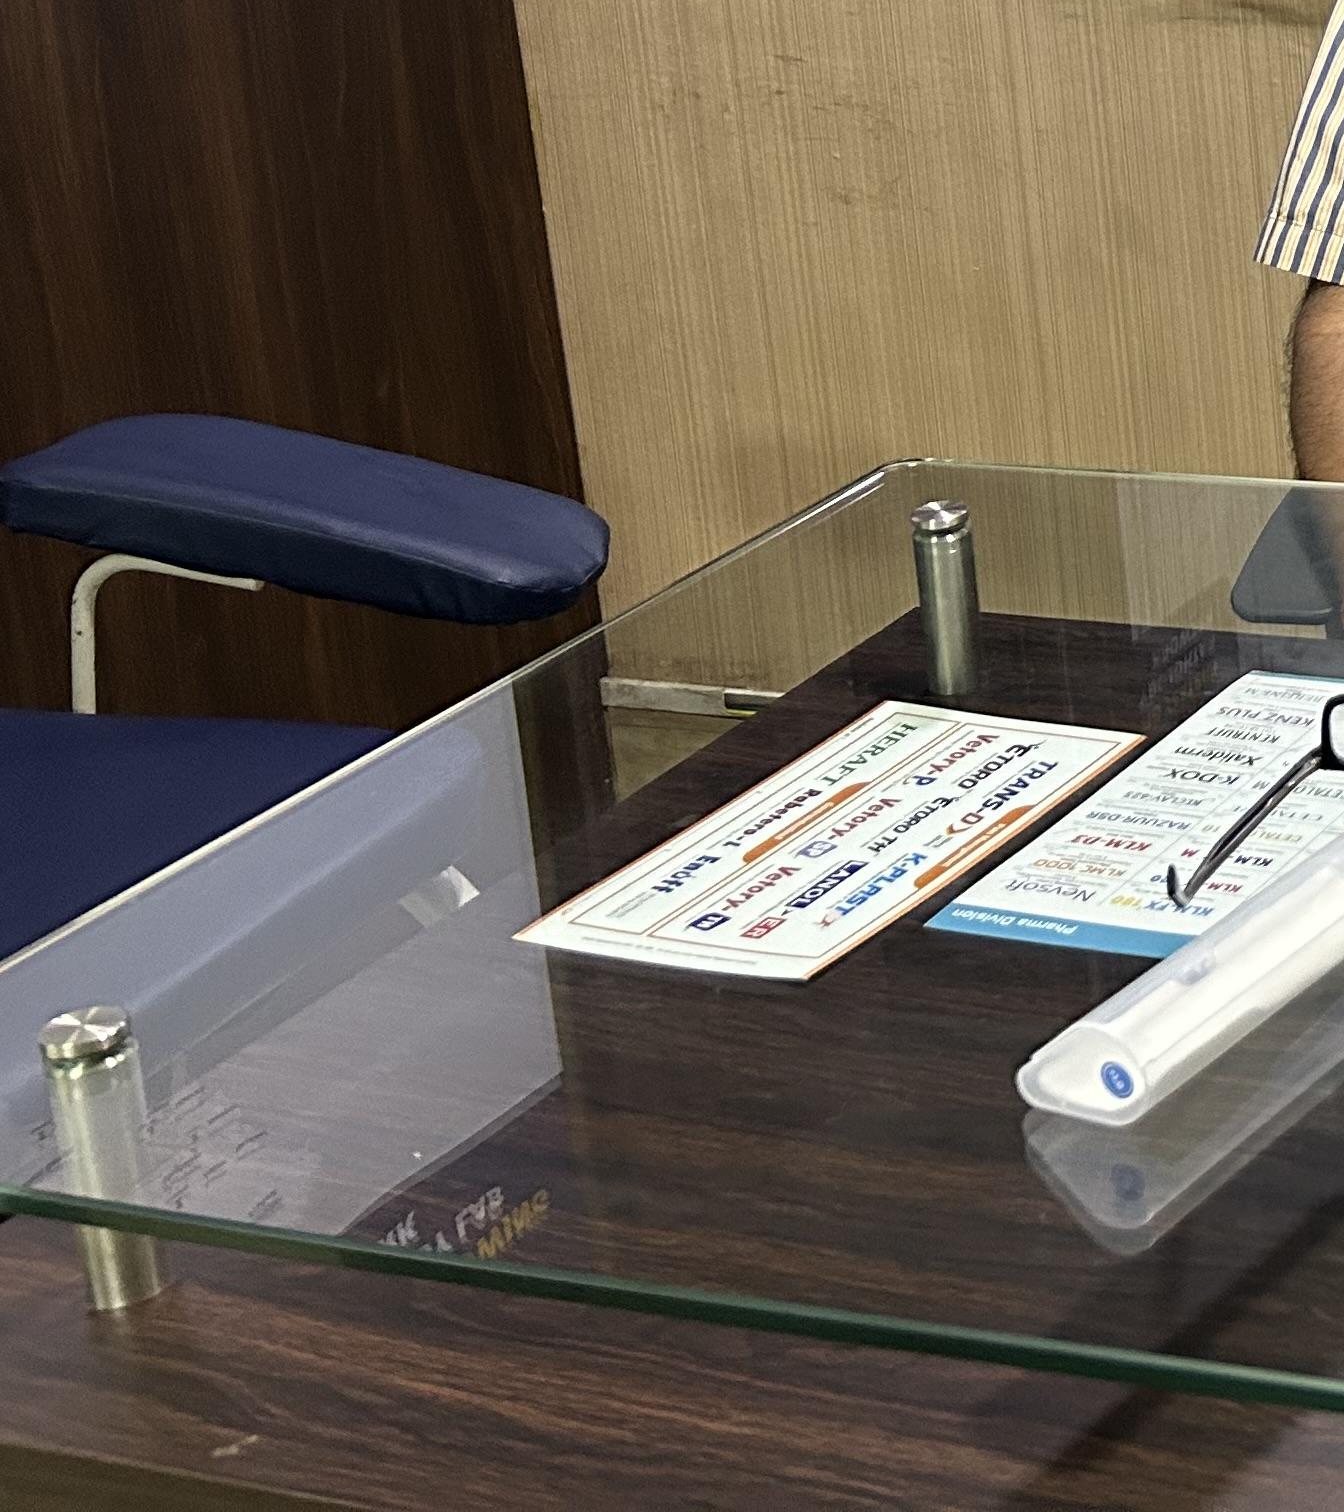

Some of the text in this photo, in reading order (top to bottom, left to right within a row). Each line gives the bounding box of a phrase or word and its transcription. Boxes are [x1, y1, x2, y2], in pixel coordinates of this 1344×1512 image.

[1216, 707, 1315, 727] KENZ PLUS
[822, 724, 918, 785] HERAFT
[1175, 747, 1261, 766] Xaliderm
[1164, 769, 1240, 785] K-DOX
[1030, 859, 1077, 870] 1000
[1006, 880, 1096, 902] Nevsoft
[952, 909, 1078, 935] Pharma Division
